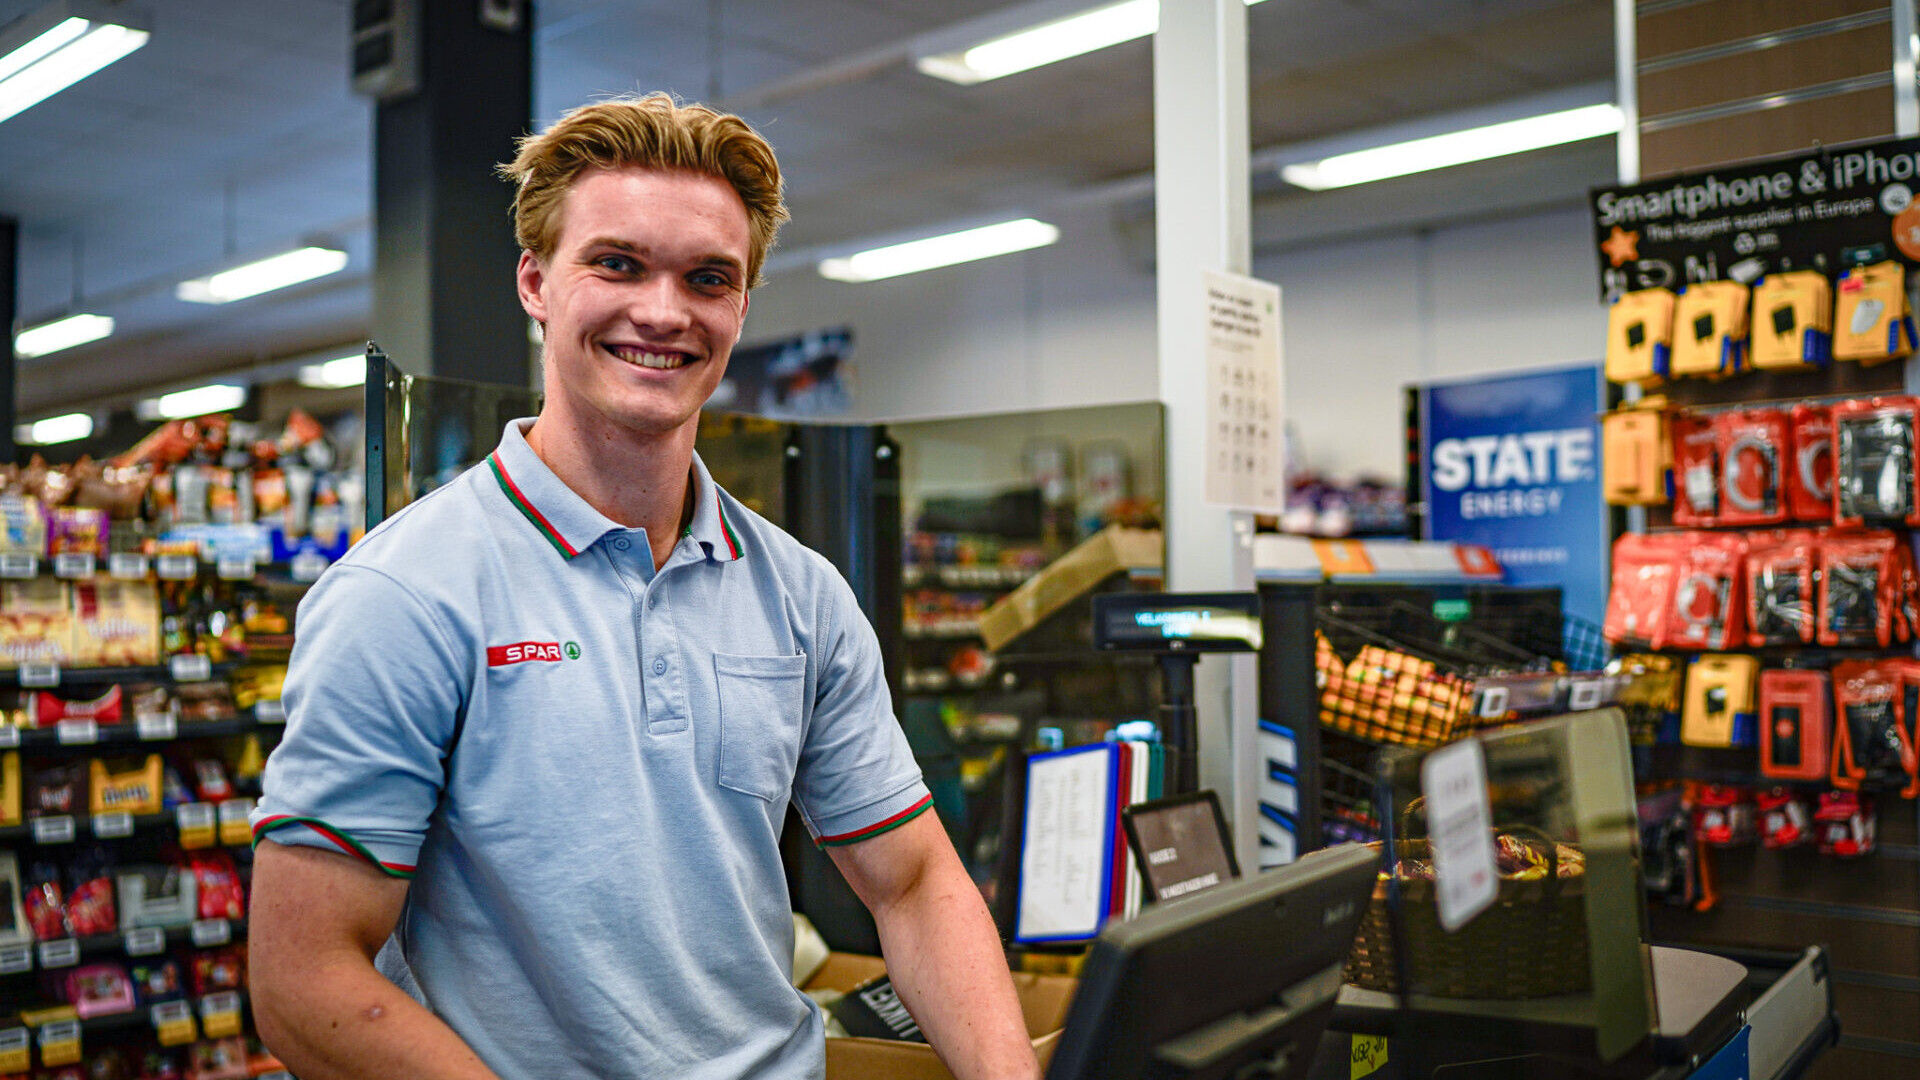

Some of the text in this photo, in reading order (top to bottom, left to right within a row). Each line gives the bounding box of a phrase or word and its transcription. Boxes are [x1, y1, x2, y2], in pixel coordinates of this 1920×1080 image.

[1597, 149, 1920, 226] Smartphone & iPho
[1813, 196, 1875, 219] Europe
[1432, 428, 1593, 491] STATE
[1460, 487, 1564, 520] ENERGY
[506, 644, 561, 661] SPAR
